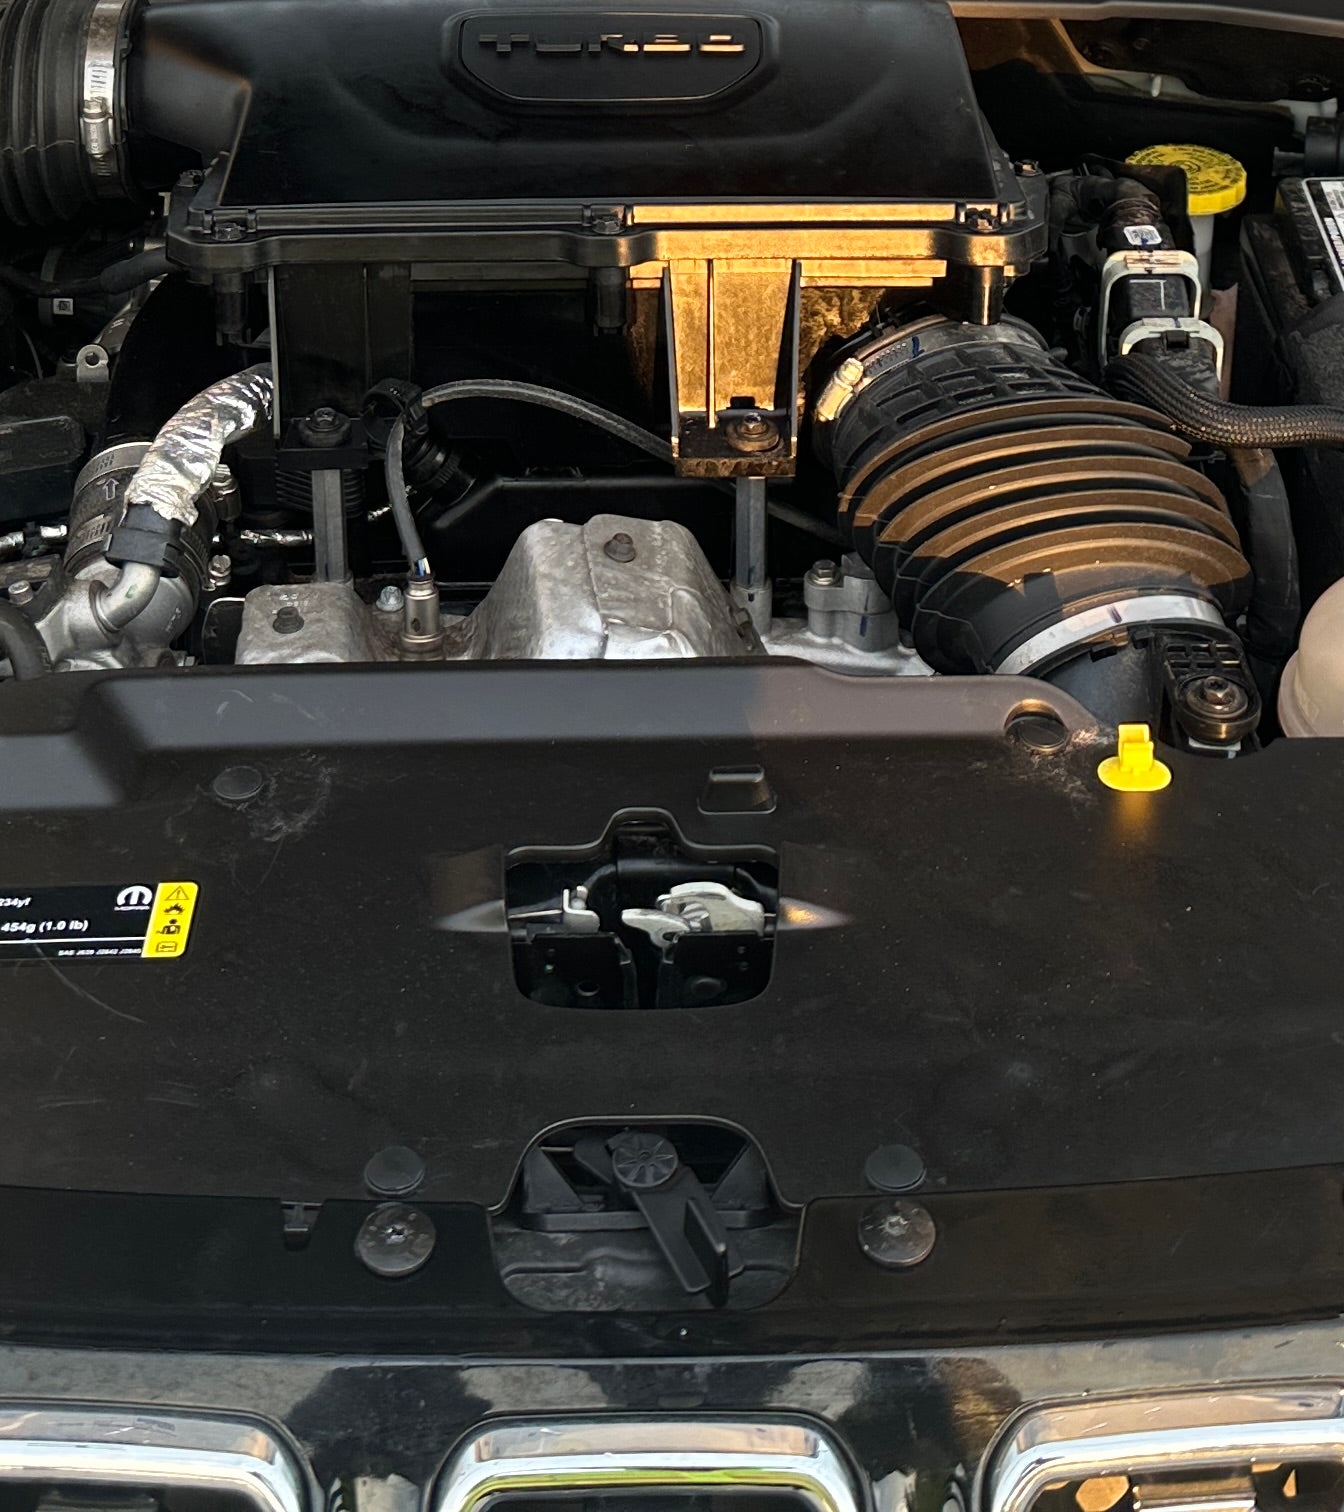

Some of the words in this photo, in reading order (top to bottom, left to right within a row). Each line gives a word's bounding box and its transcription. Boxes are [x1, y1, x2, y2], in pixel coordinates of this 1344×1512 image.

[0, 922, 36, 933] 454g
[38, 920, 66, 934] (1.0
[69, 919, 88, 932] lb)
